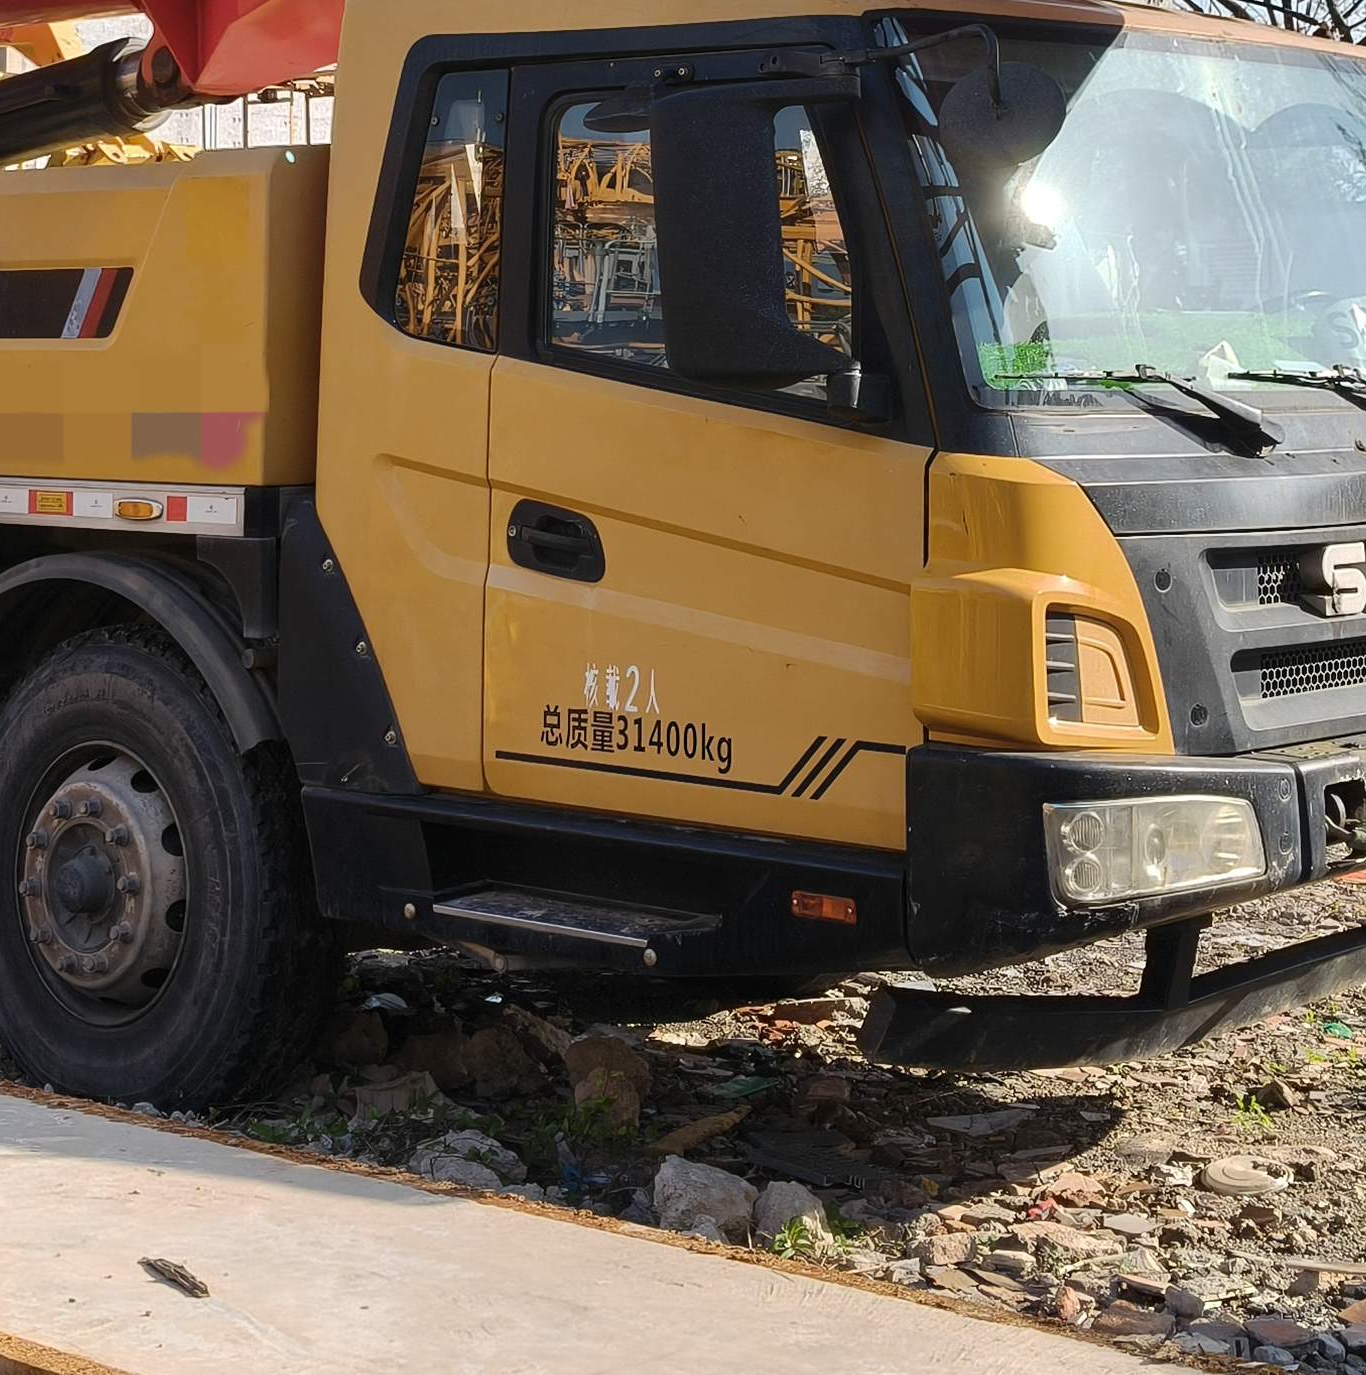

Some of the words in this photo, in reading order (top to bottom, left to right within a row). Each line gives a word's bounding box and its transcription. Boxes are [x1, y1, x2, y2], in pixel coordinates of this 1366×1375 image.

[584, 663, 660, 715] 核载2人
[541, 704, 733, 774] 总质量31400kg
